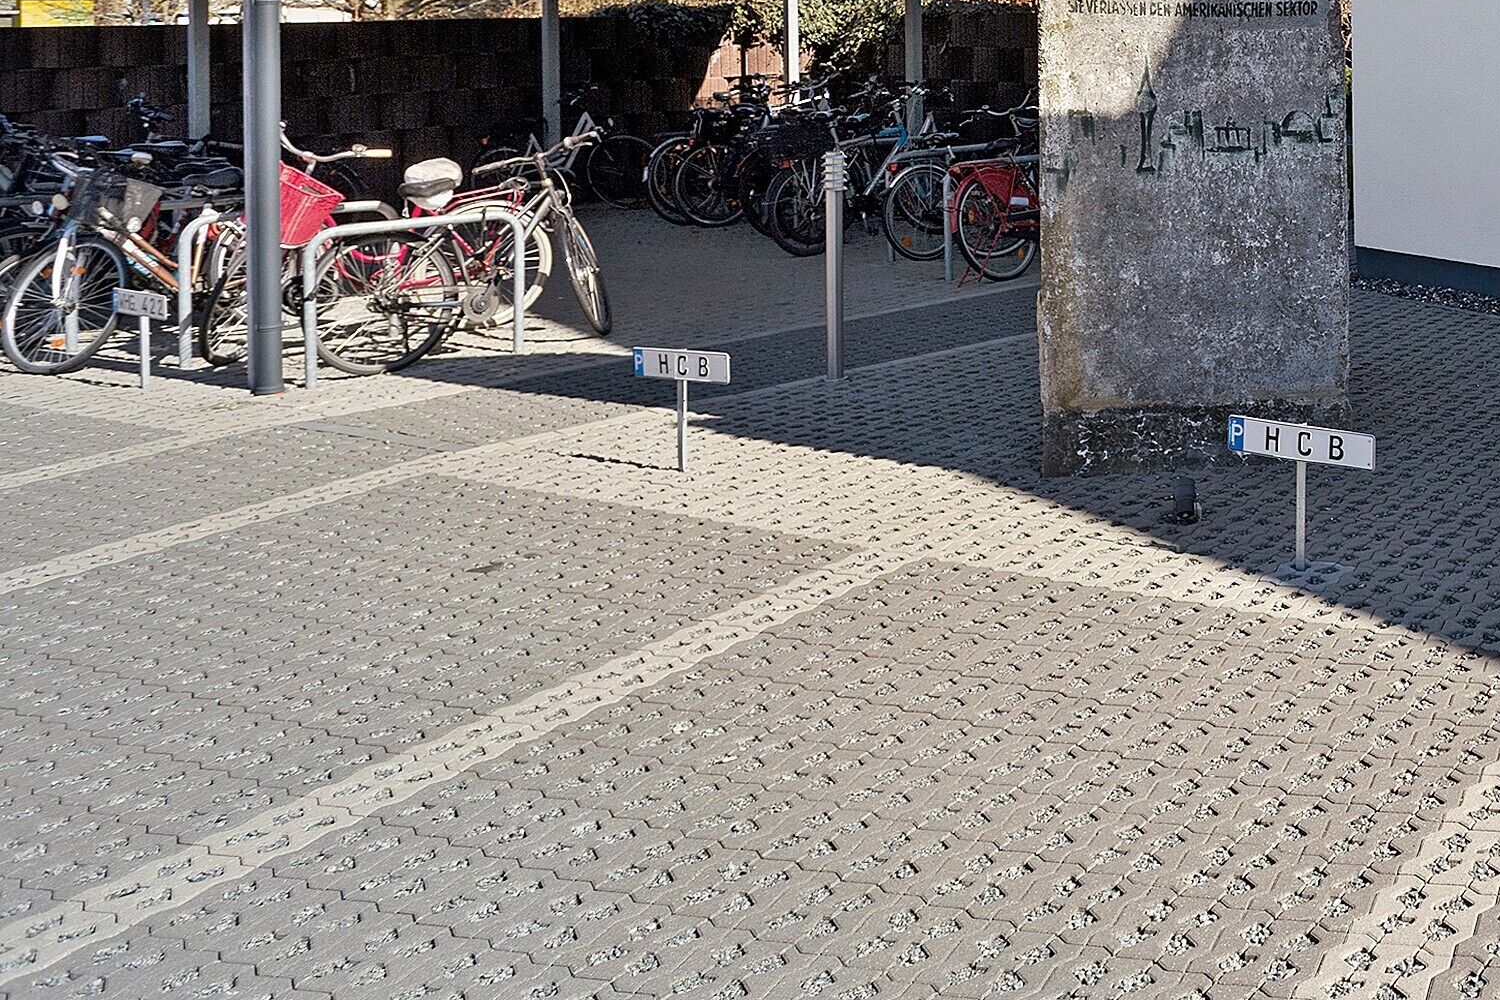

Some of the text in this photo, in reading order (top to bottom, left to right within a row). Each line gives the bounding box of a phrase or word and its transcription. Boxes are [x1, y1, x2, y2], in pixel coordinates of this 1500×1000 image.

[1150, 1, 1171, 16] DEN
[1174, 1, 1272, 18] AMERIKANISCHEN
[1276, 0, 1318, 16] SEKTOR
